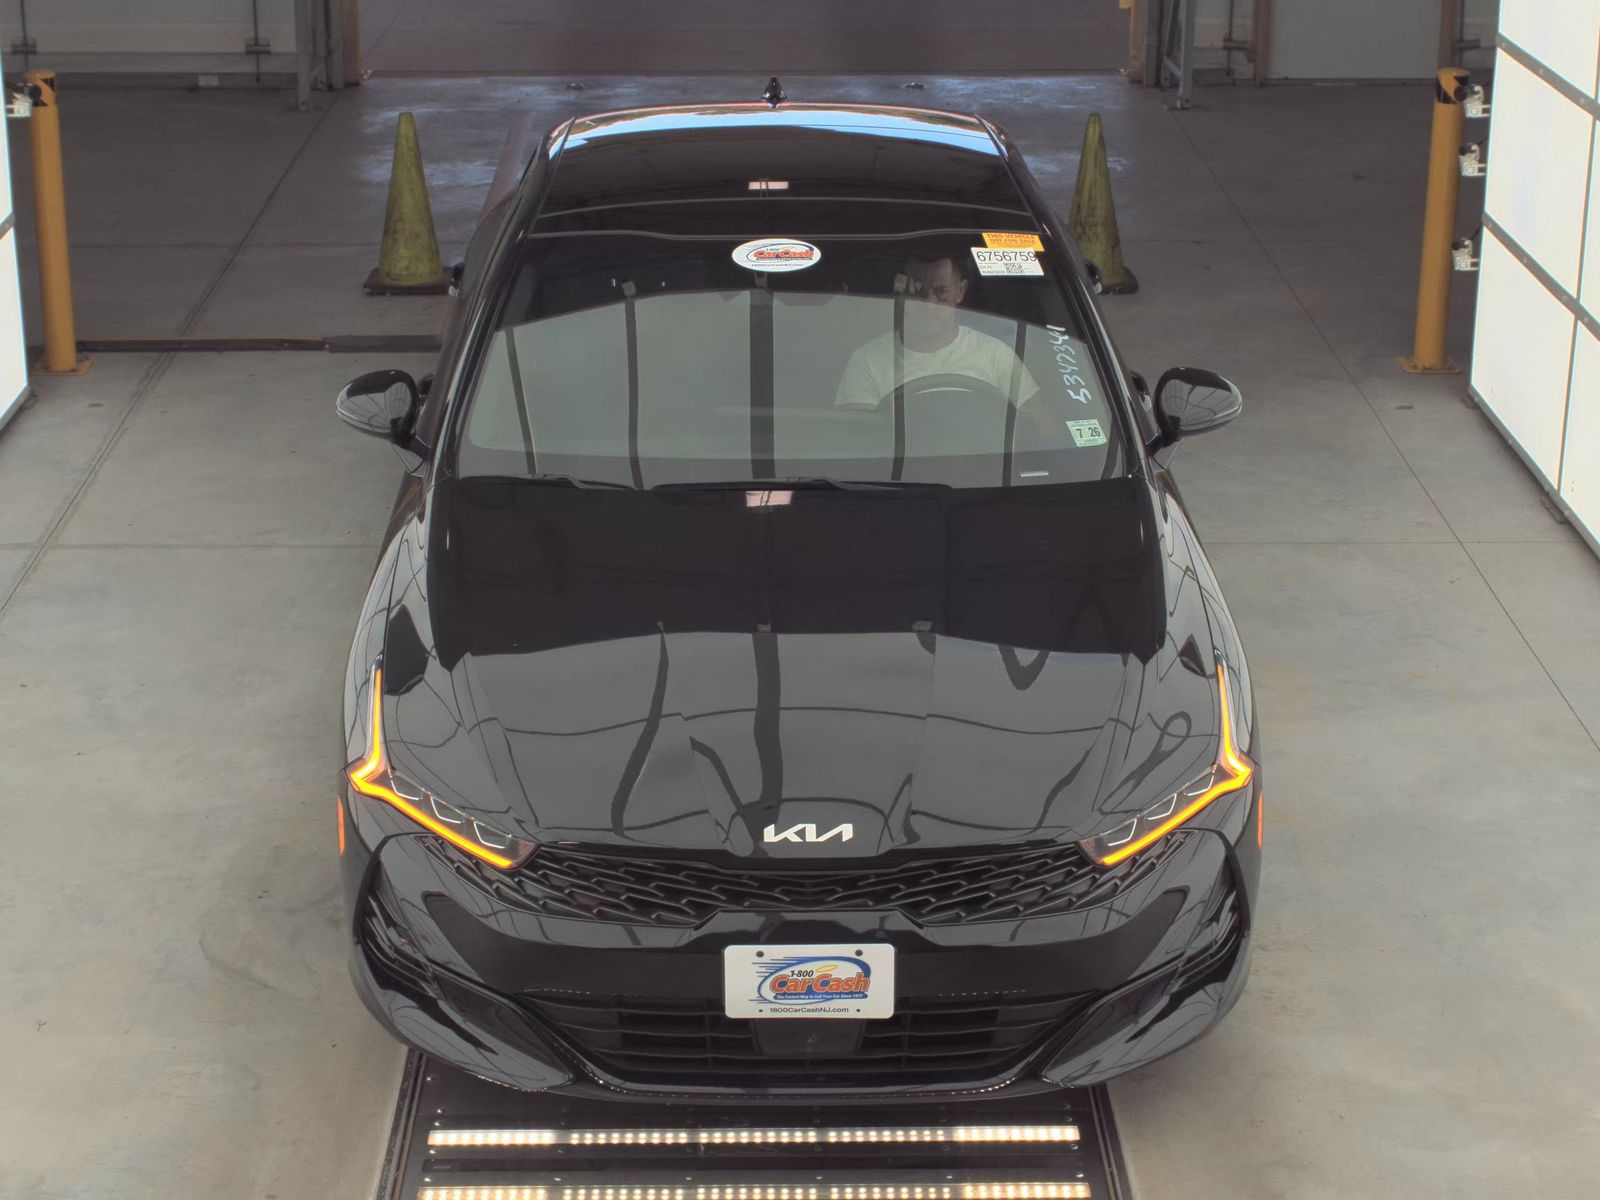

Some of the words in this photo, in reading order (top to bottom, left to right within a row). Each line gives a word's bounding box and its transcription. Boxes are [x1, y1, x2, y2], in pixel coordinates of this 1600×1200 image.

[976, 250, 1036, 262] 6756759
[1076, 428, 1082, 438] 7
[1088, 426, 1101, 437] 26
[763, 823, 854, 842] KIA
